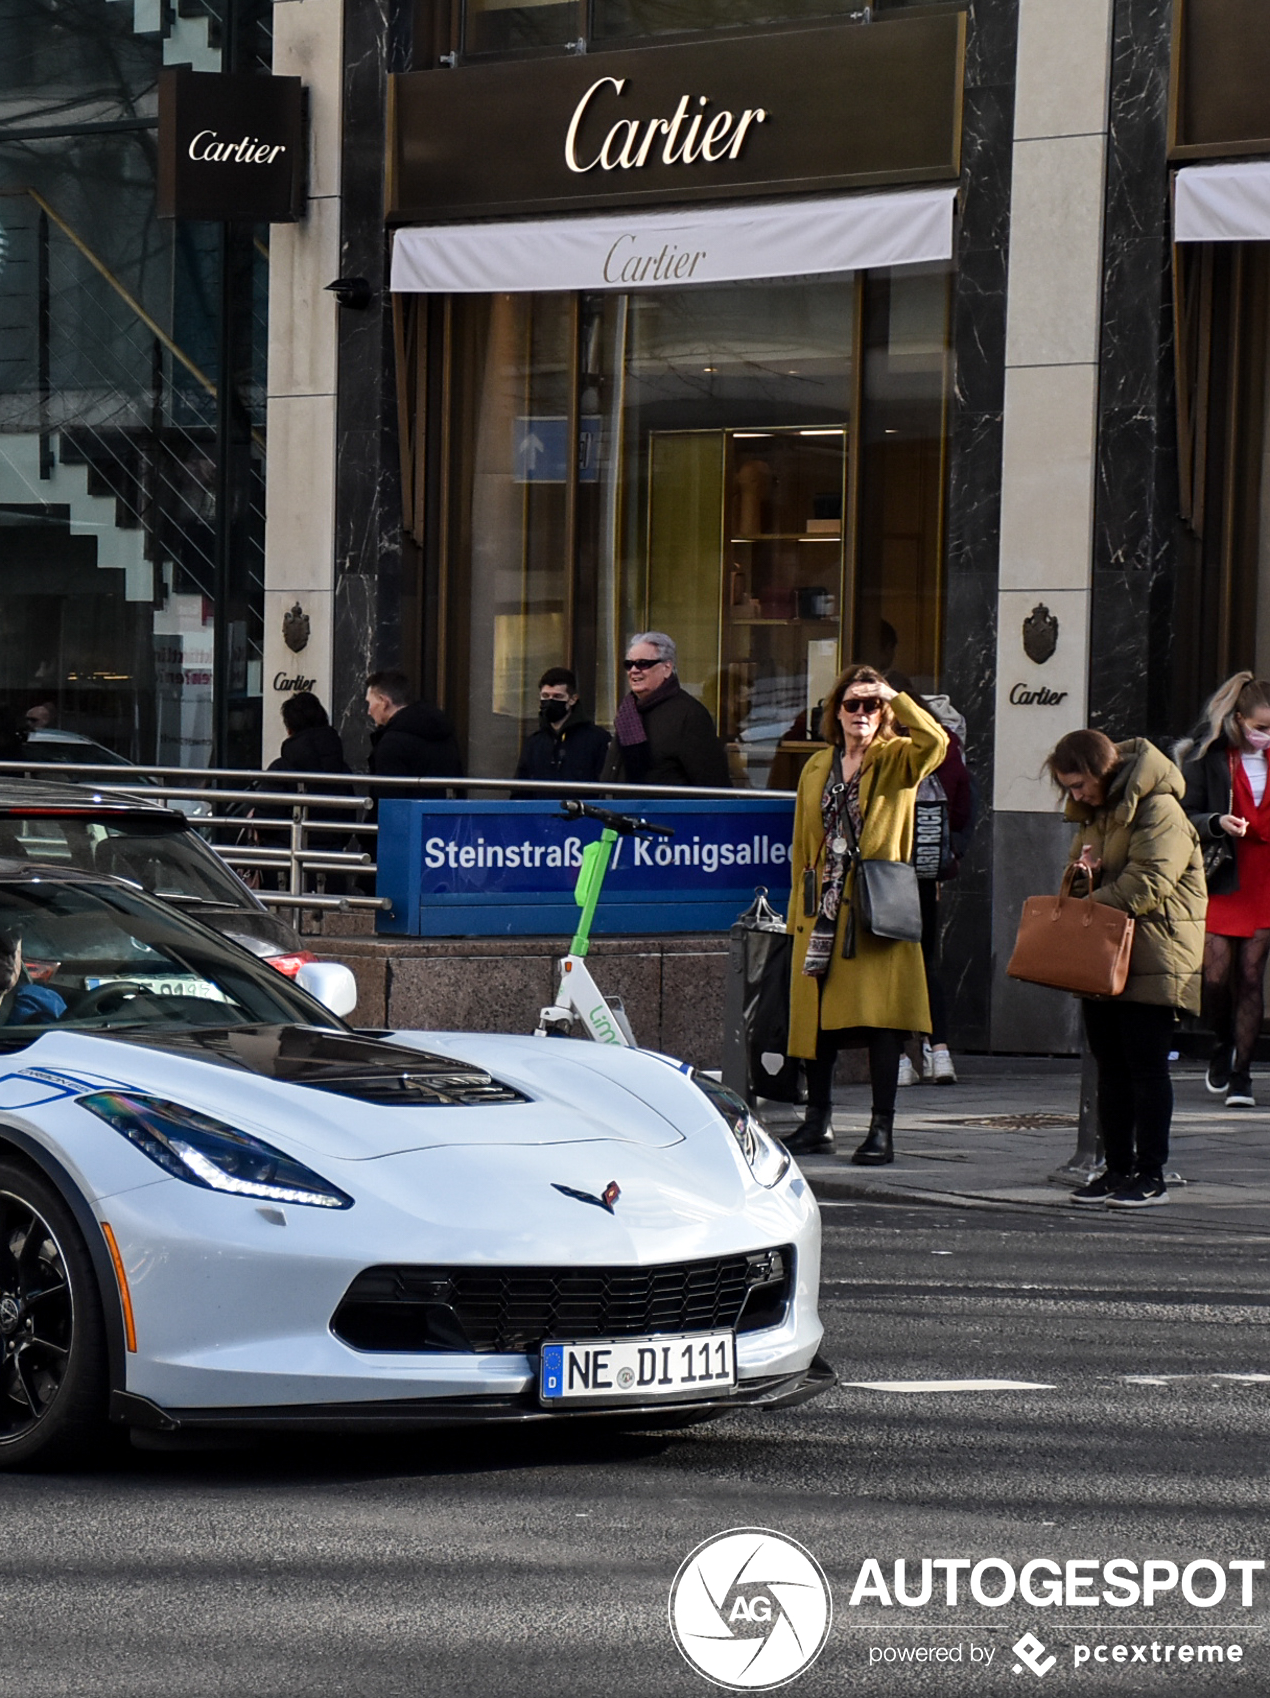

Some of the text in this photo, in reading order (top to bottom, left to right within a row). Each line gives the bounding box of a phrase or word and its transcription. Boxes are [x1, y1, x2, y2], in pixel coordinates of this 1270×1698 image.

[565, 77, 766, 173] Cartier
[188, 130, 286, 164] Cartier
[603, 234, 707, 284] Cartier
[273, 671, 316, 692] Cartier
[1009, 682, 1068, 706] Cartier
[917, 805, 942, 844] ROCK
[424, 837, 583, 869] Steinstraß
[568, 1340, 730, 1390] NE DI 111
[548, 1376, 557, 1389] D
